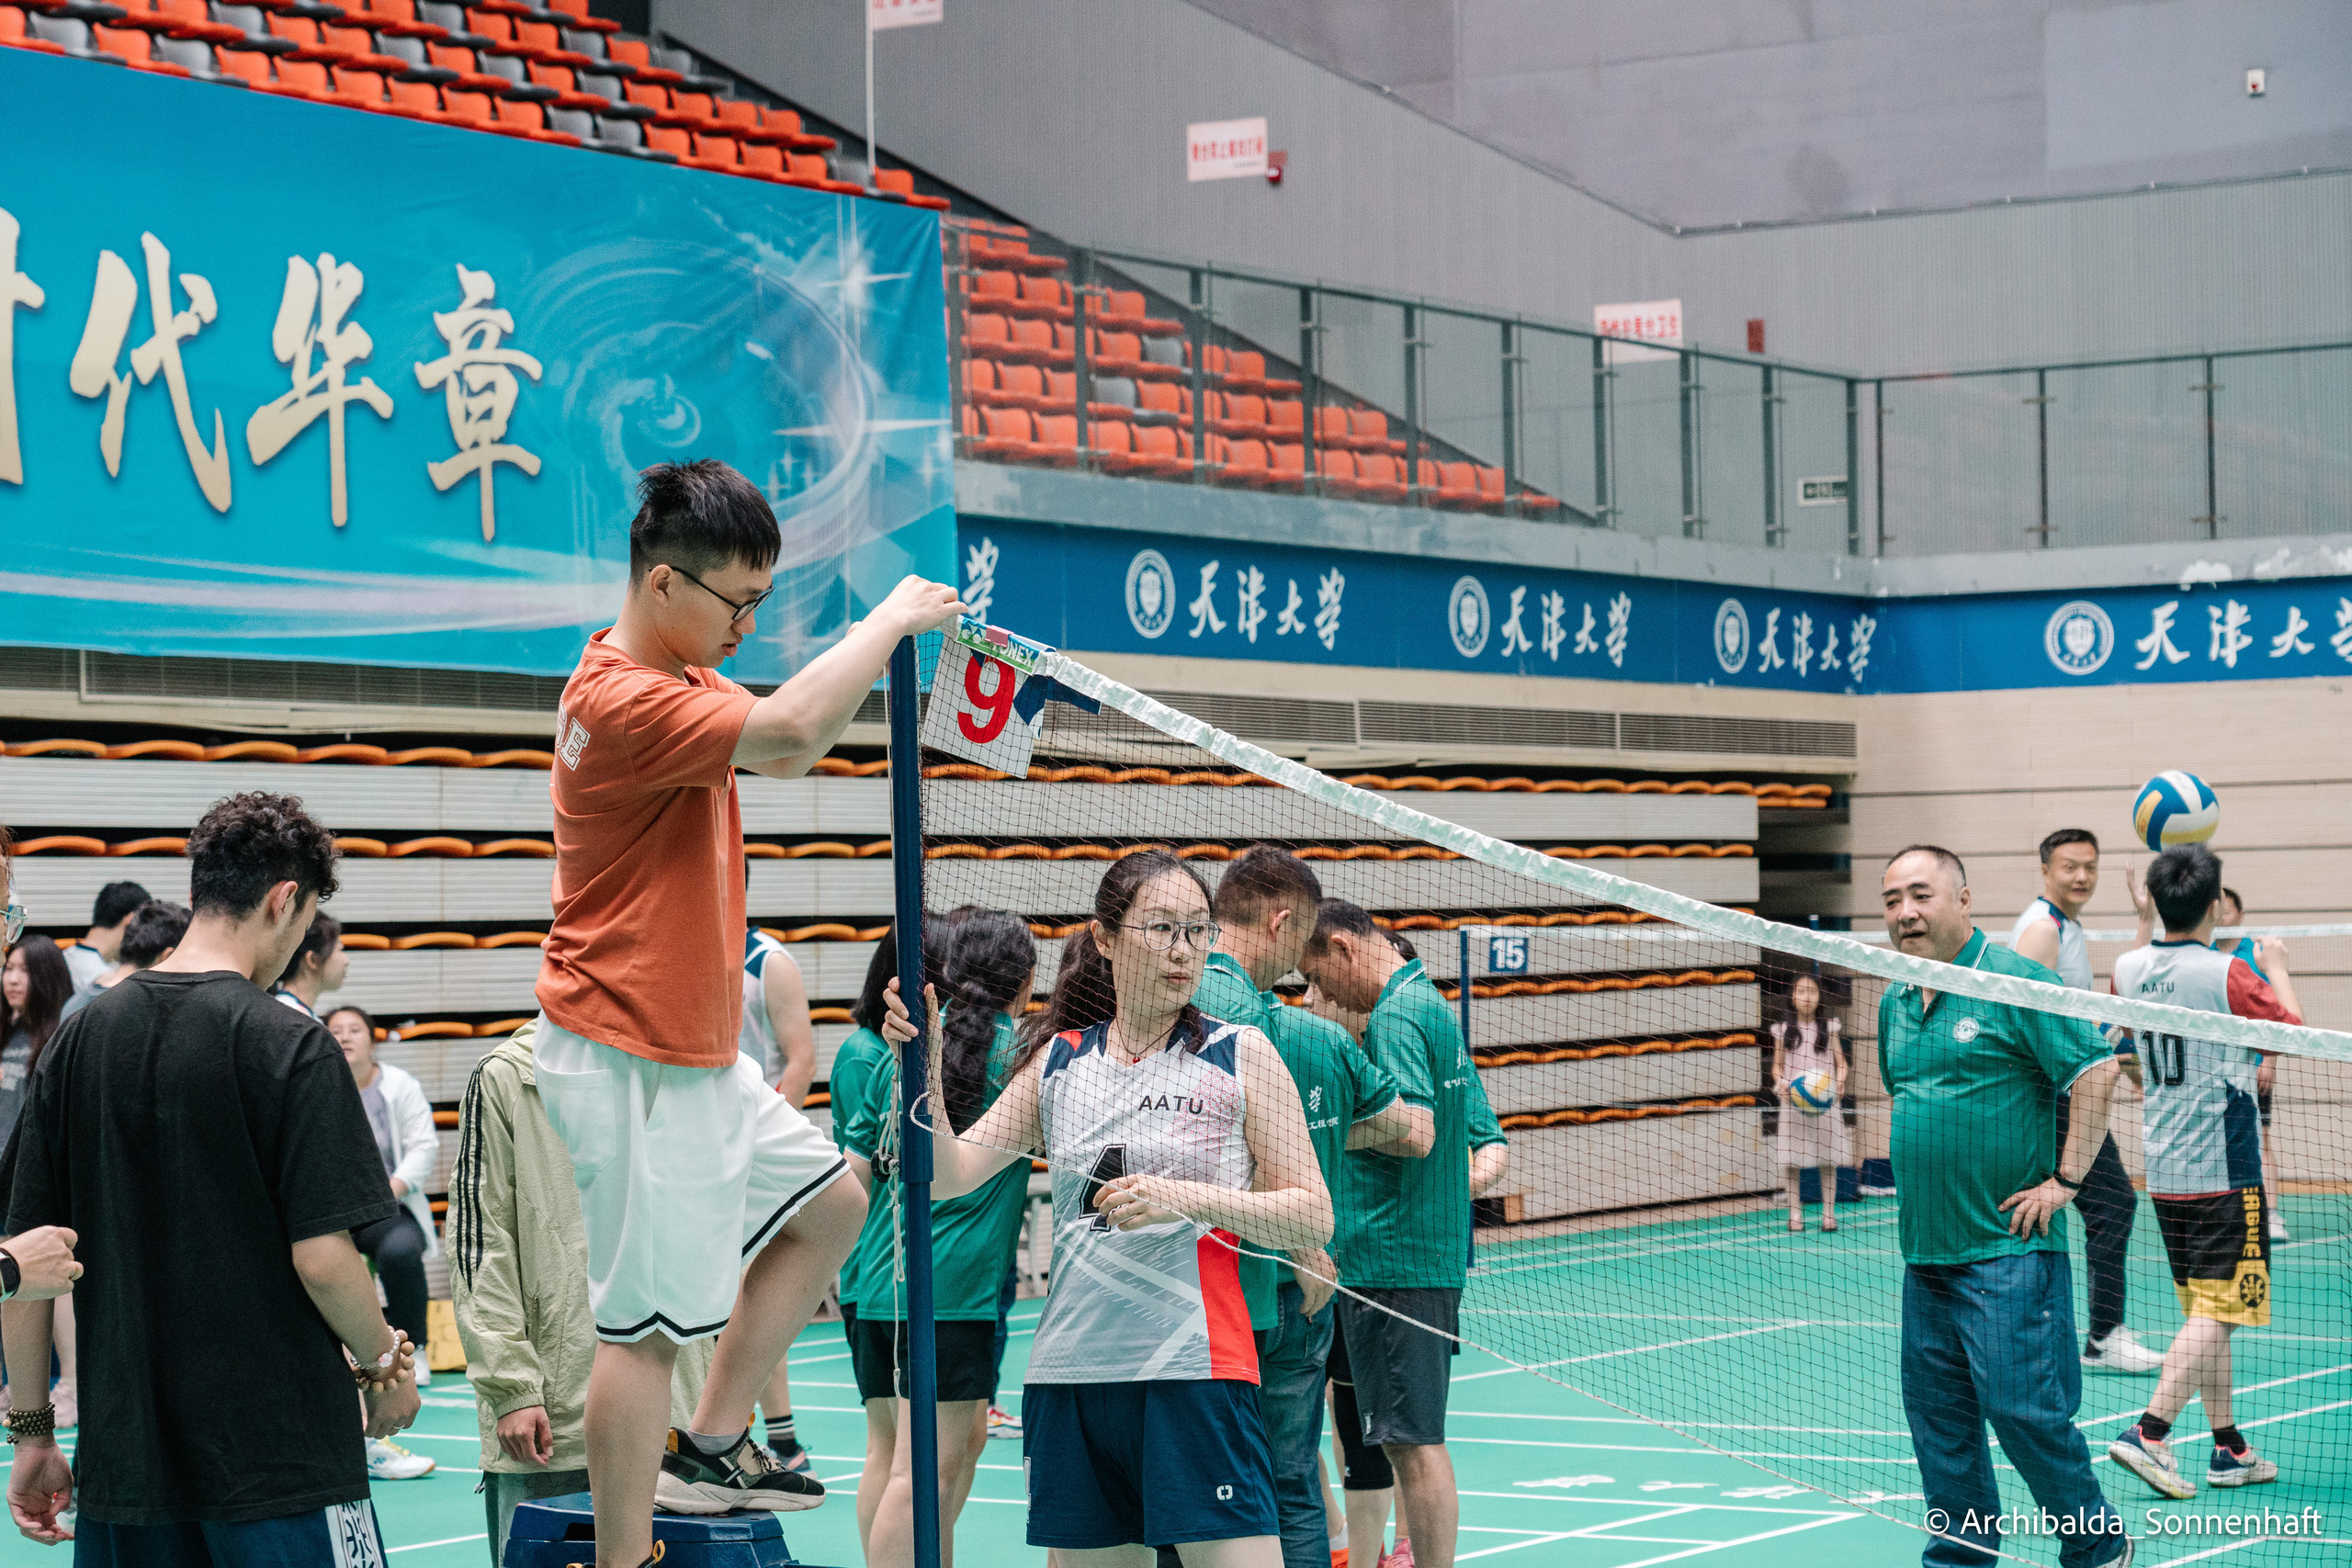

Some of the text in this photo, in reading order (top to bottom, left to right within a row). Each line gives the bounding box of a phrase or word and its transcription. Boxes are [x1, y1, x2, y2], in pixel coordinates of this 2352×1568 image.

[1189, 559, 1346, 651] 天津大学
[1500, 584, 1632, 668] 天津大学
[1758, 606, 1877, 682] 天津大学
[957, 655, 1016, 743] 9
[1492, 938, 1526, 969] 15
[2142, 980, 2175, 994] AATU
[1137, 1094, 1204, 1114] AATU
